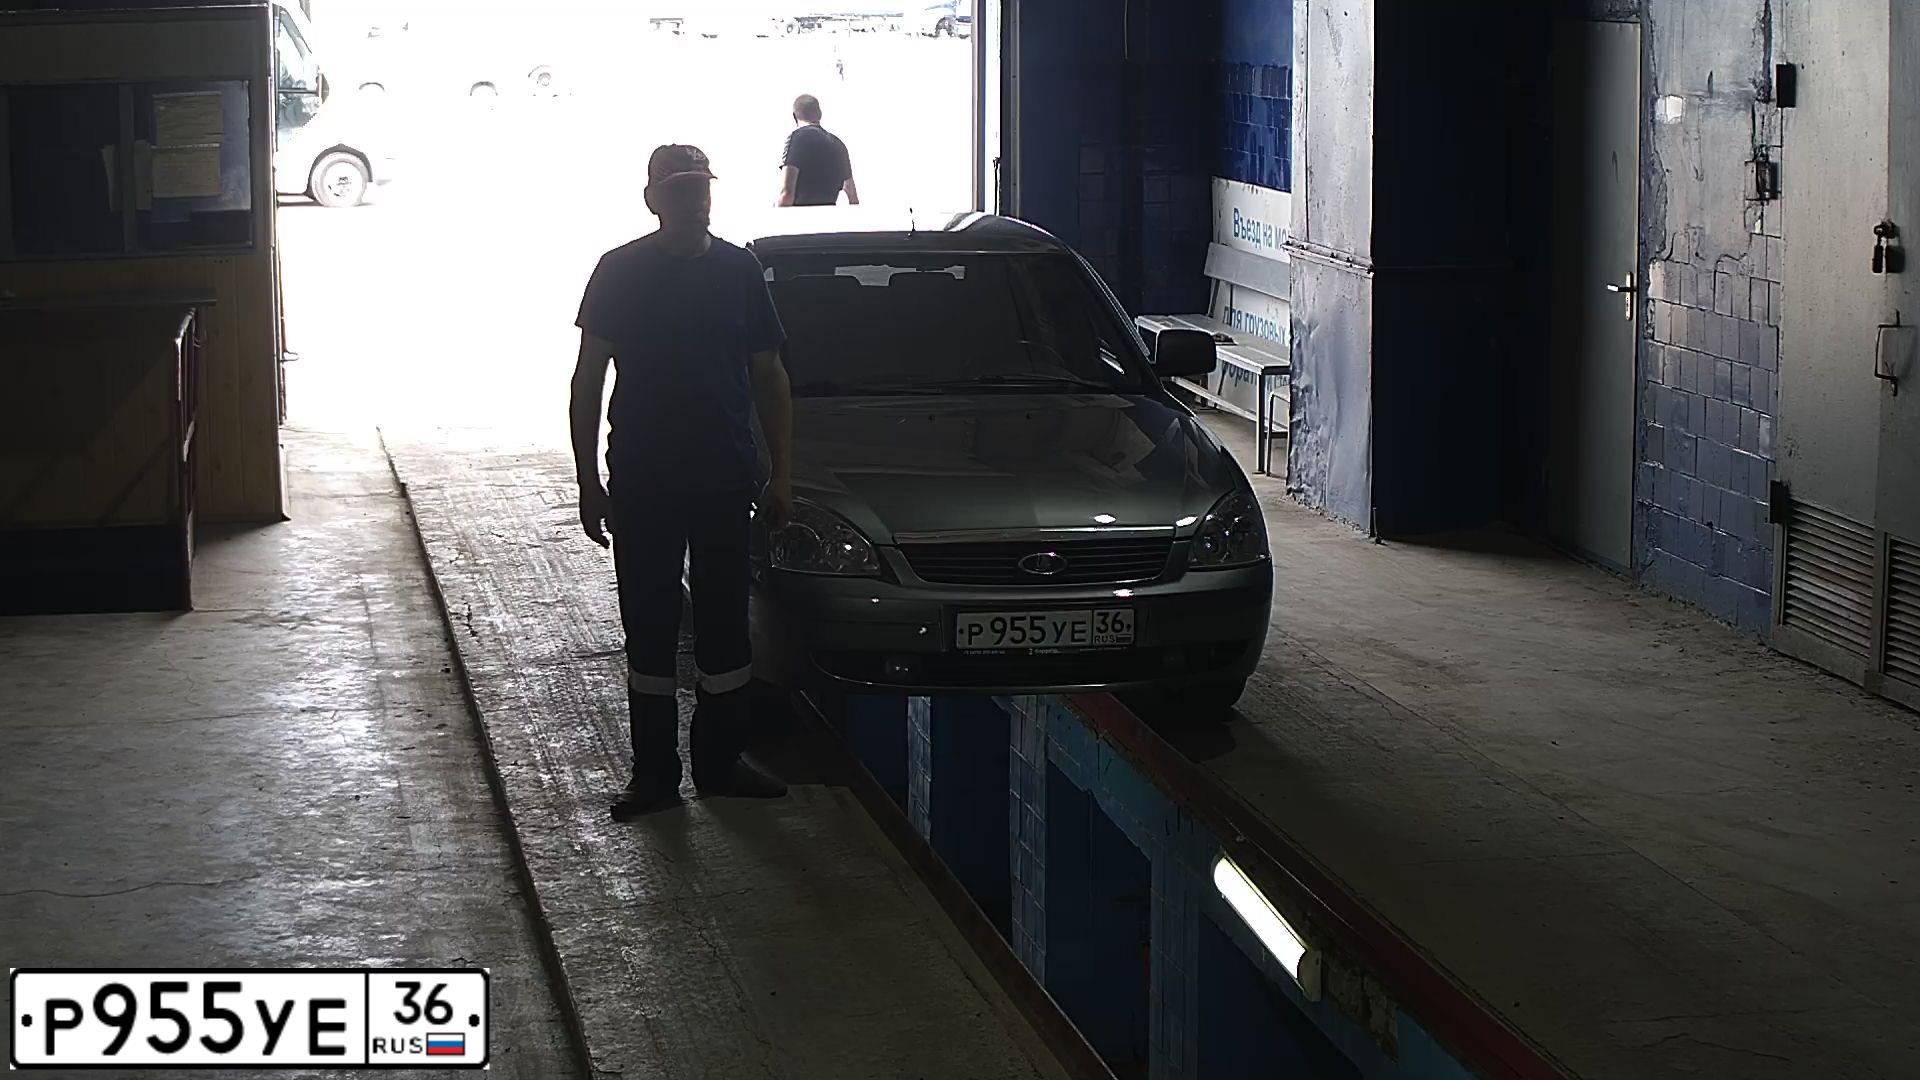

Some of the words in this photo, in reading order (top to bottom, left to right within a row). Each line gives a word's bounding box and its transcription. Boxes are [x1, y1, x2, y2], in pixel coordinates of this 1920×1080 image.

[1233, 207, 1262, 250] Въезд
[1263, 223, 1273, 247] на
[1275, 226, 1289, 250] мо
[1244, 312, 1286, 344] грузовых
[1095, 612, 1124, 634] 36
[1095, 635, 1116, 643] RUS
